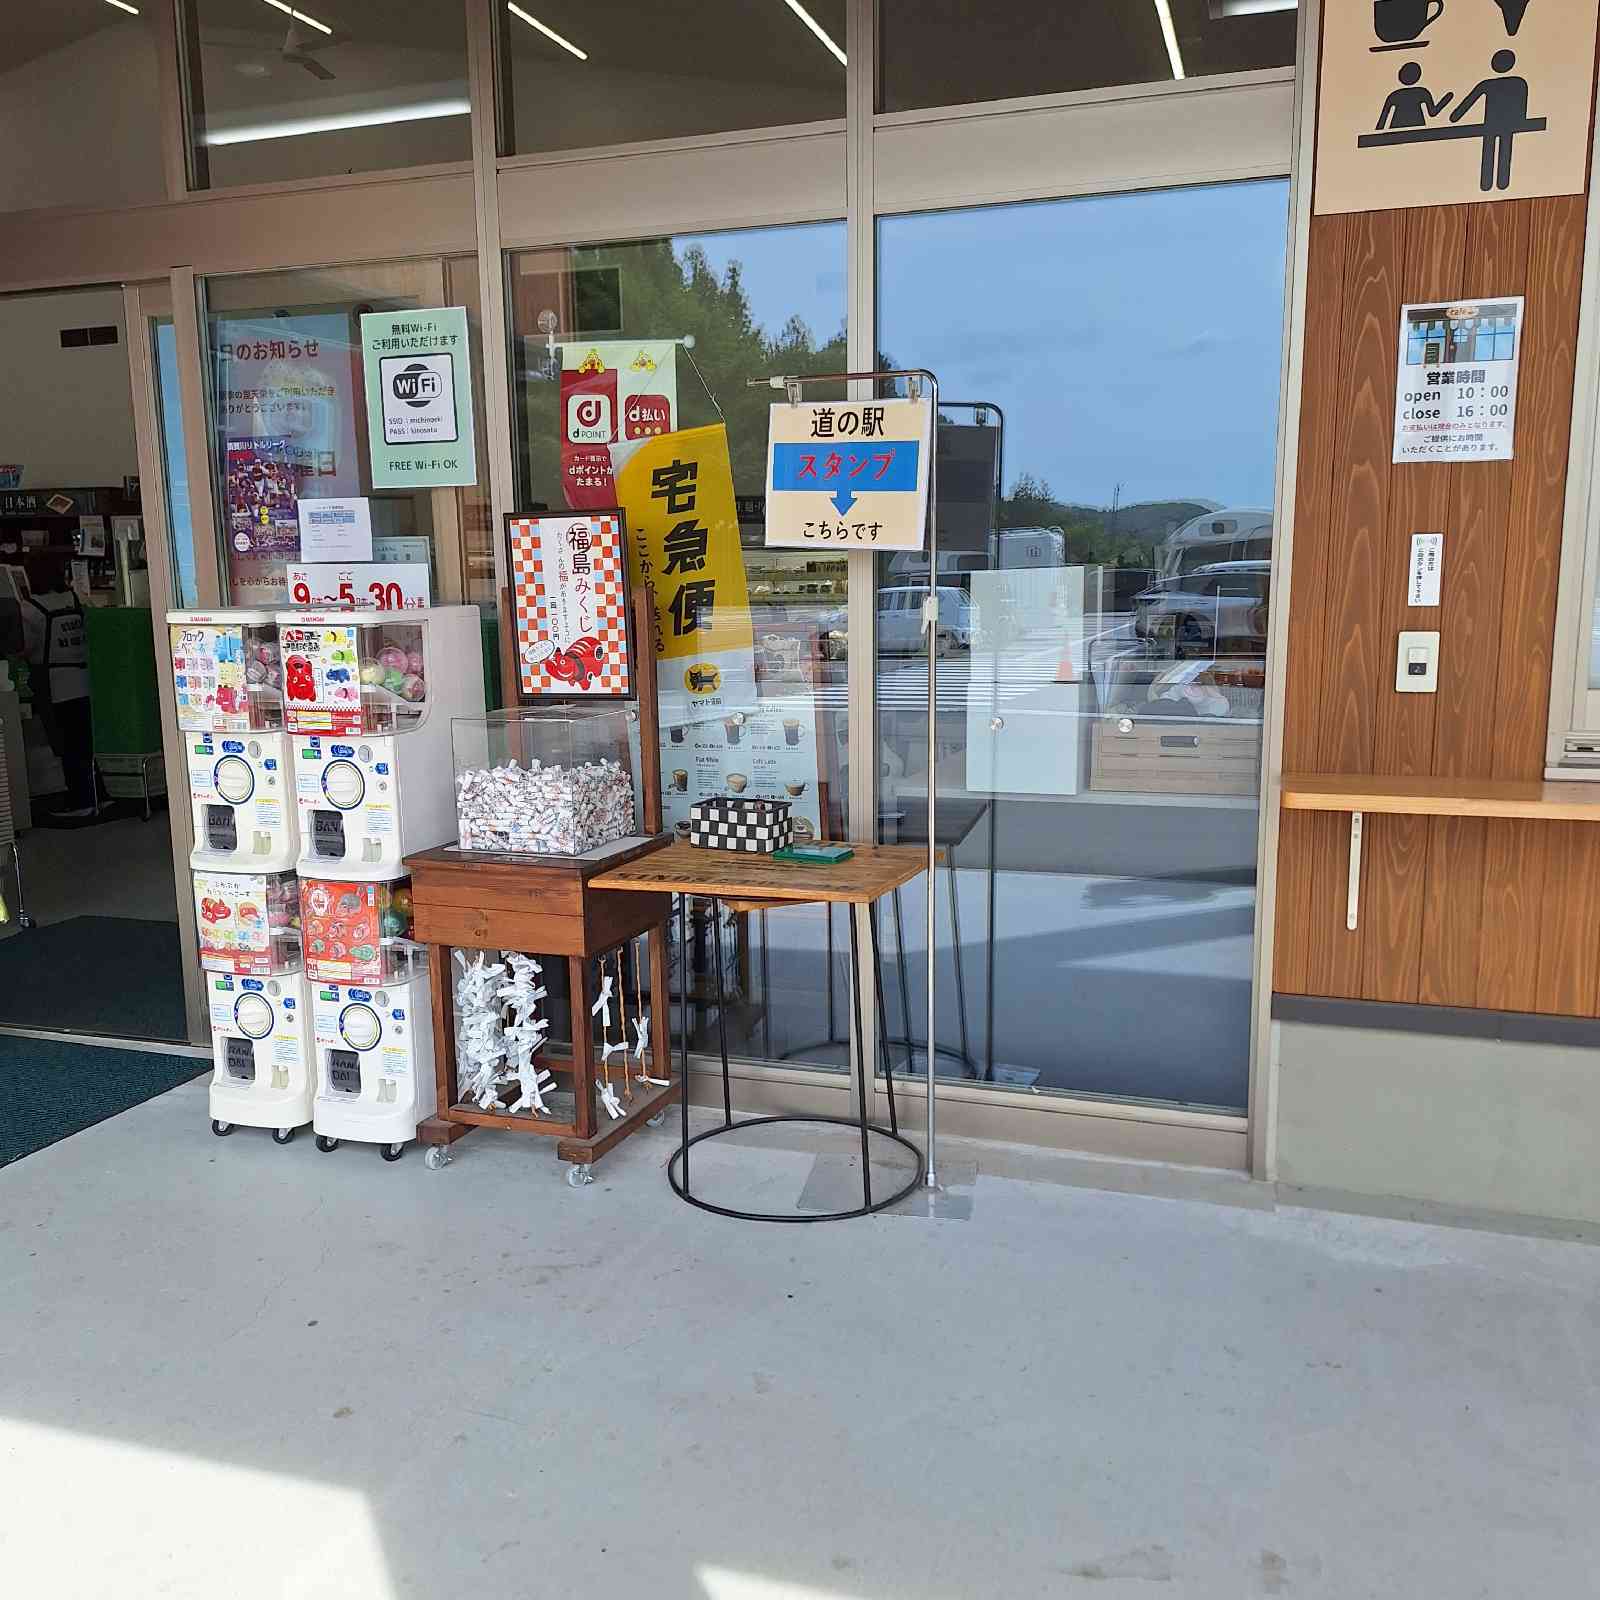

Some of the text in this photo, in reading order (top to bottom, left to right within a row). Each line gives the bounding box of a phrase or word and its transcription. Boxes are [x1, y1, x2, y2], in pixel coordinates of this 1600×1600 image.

[391, 323, 437, 335] 無料Wi-Fi
[372, 335, 458, 350] ご利用いただけます
[212, 340, 319, 362] 日のお知らせ
[1426, 370, 1486, 385] 営業時間
[1404, 391, 1441, 404] open
[628, 406, 666, 422] d払い
[1403, 408, 1441, 420] close
[811, 407, 885, 437] 道の駅
[581, 430, 607, 439] POINT
[1423, 433, 1484, 443] ご提供にお時間
[1402, 443, 1500, 454] いただくことがあります。
[389, 459, 458, 471] FREE Wi-Fi OK
[797, 448, 896, 480] スタンプ
[803, 520, 883, 541] こちらです
[651, 459, 716, 636] 宅急便
[567, 526, 593, 633] 福島みくじ
